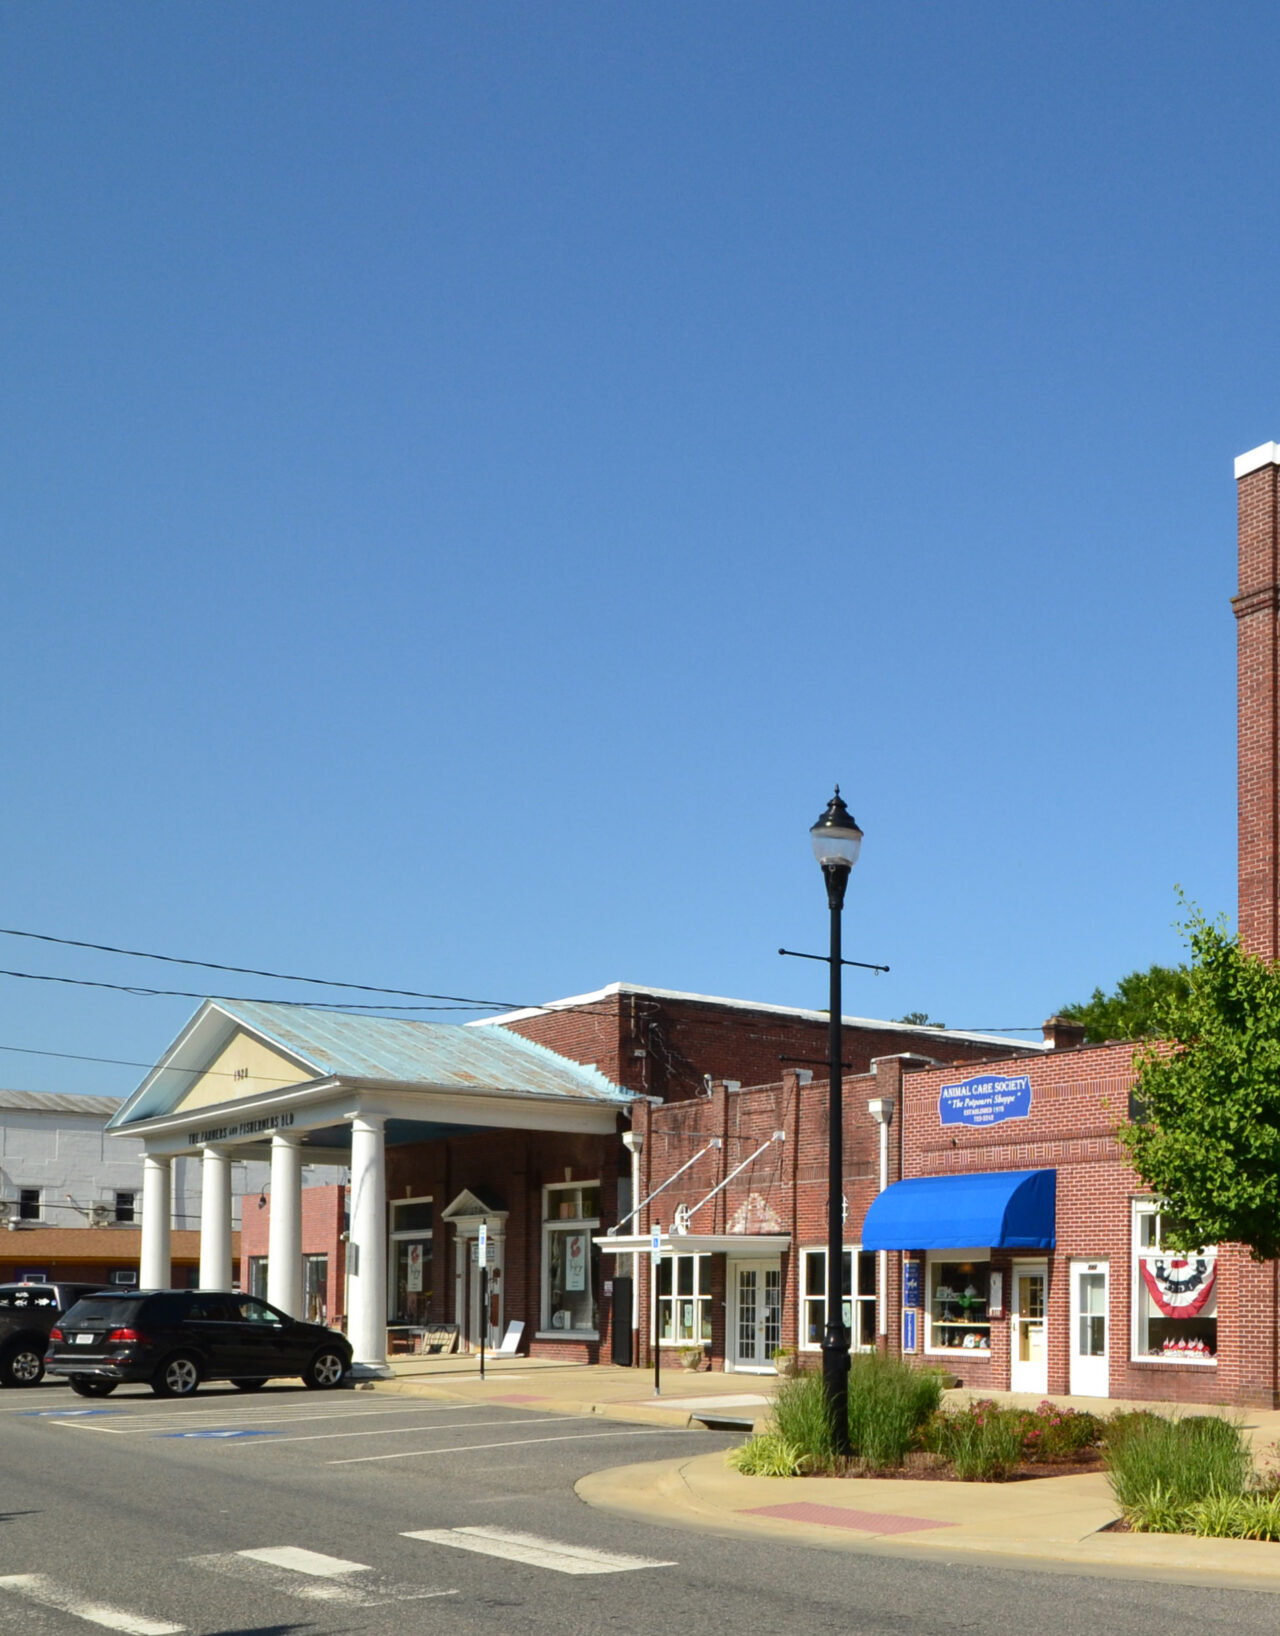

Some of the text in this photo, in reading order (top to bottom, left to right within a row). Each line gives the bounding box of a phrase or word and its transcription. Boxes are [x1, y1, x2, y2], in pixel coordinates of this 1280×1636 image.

[943, 1078, 1027, 1098] ANIMAL CARE SOCIETY
[964, 1095, 993, 1107] Potpourri
[964, 1107, 992, 1116] ESTABLISHED
[188, 1132, 199, 1145] THE
[200, 1127, 228, 1142] FARMERS
